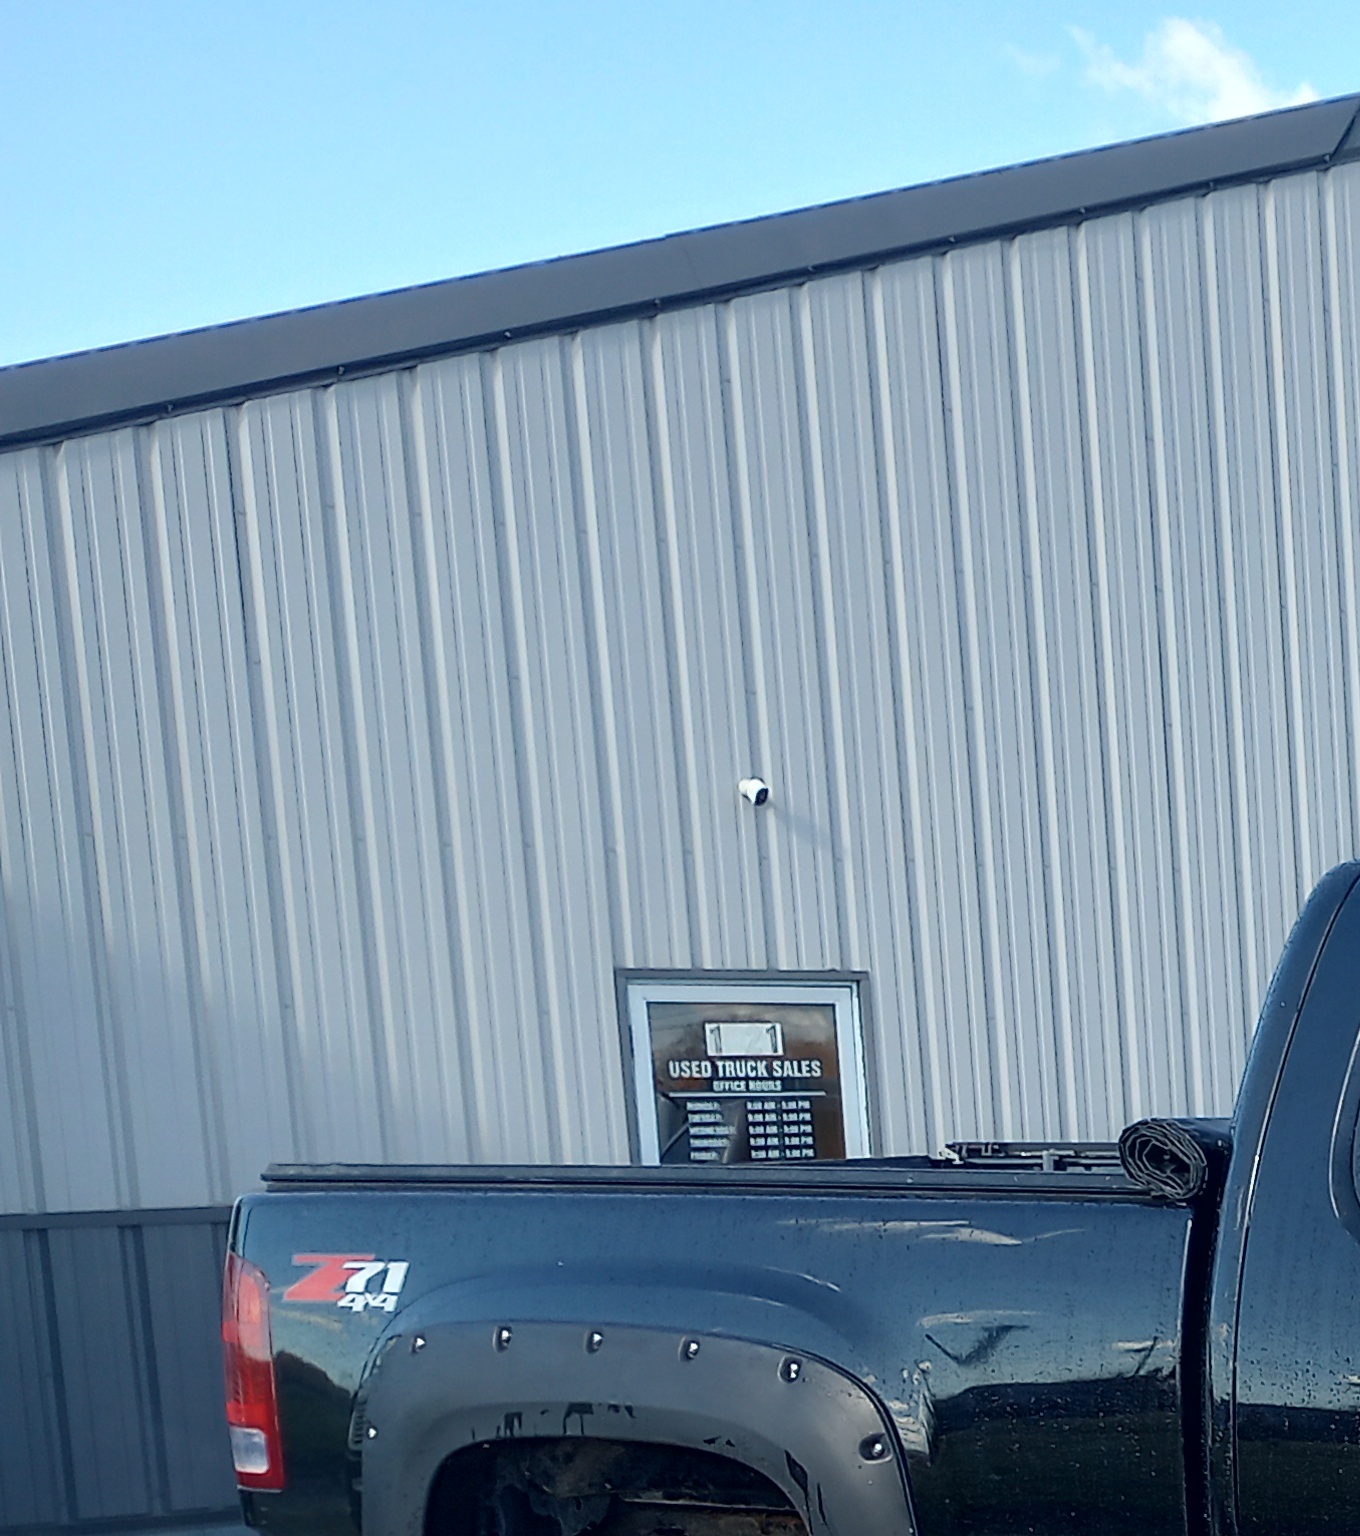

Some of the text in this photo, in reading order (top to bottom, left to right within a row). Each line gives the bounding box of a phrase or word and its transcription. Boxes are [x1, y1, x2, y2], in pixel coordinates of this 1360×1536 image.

[668, 1060, 822, 1078] USED TRUCK SALES
[284, 1254, 410, 1303] Z71
